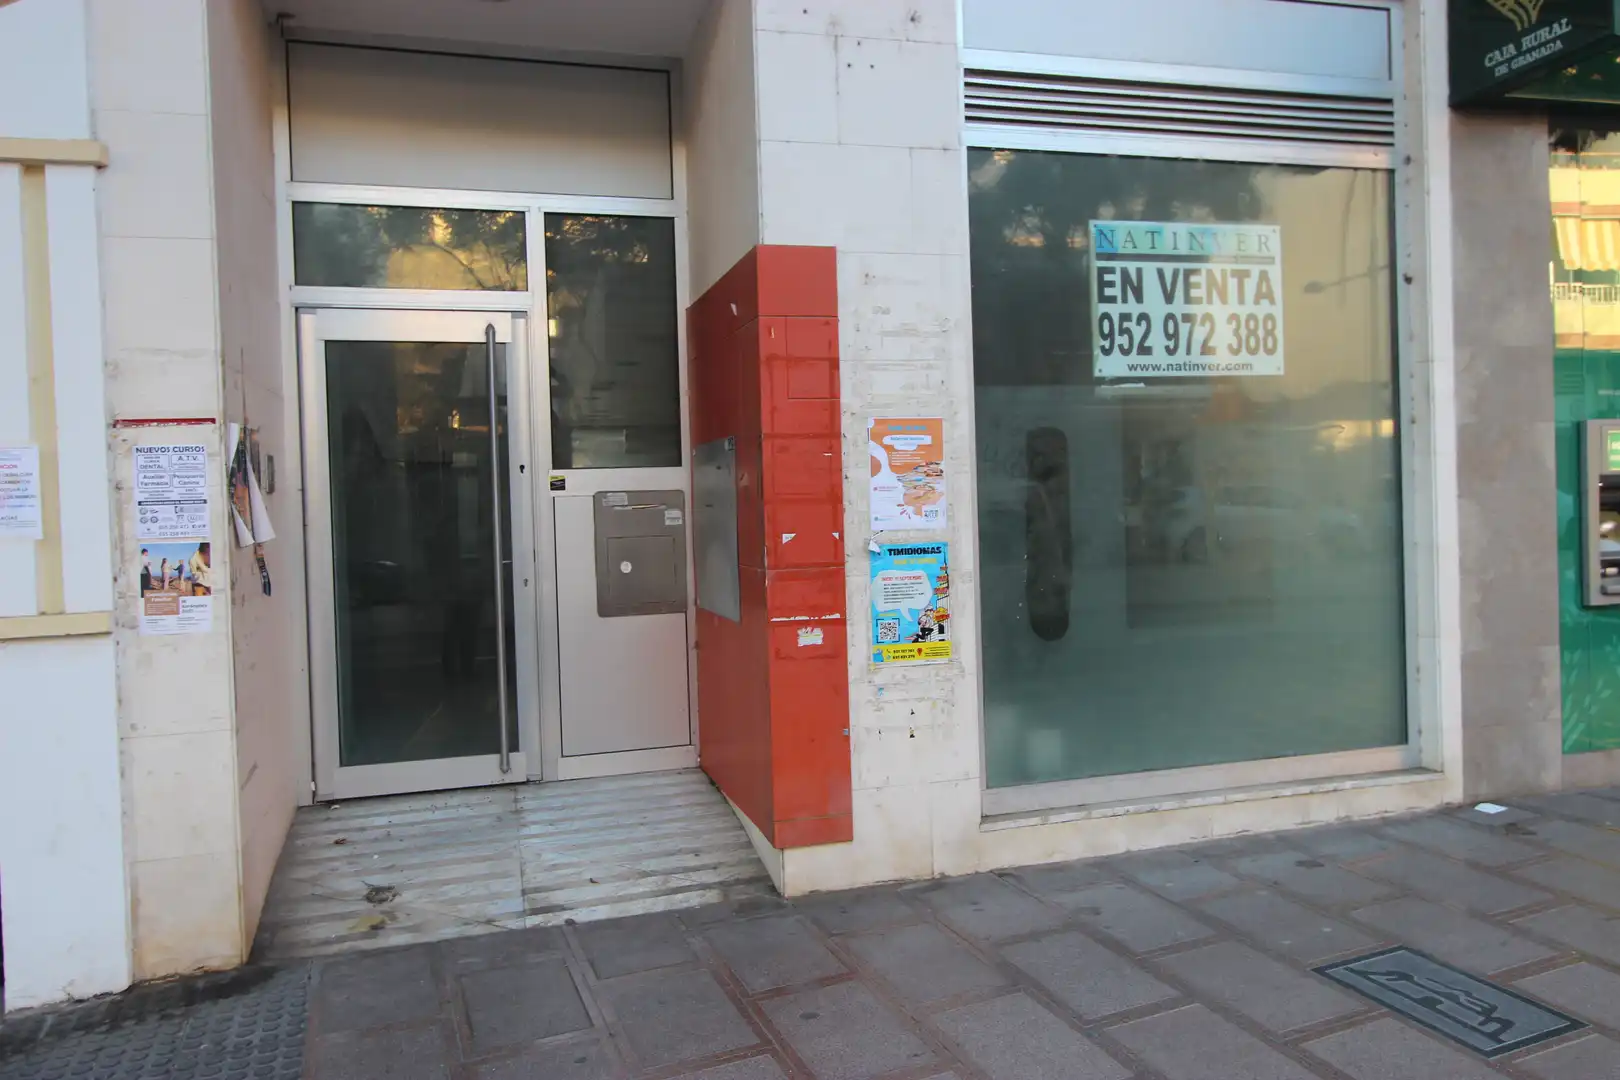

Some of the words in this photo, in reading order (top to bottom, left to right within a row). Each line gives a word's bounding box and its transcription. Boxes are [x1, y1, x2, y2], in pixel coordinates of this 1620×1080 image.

[1484, 43, 1517, 67] CAJA
[1520, 18, 1572, 51] RURAL
[1494, 63, 1509, 77] DE
[1510, 40, 1563, 70] GRANADA
[1096, 228, 1271, 253] NATINVER
[1097, 266, 1144, 304] EN
[1156, 267, 1277, 305] VENTA
[1098, 312, 1153, 357] 952
[1163, 312, 1217, 357] 972
[1227, 312, 1278, 356] 388
[1127, 361, 1253, 372] www.natinver.com
[135, 446, 171, 454] NUEVOS
[172, 445, 205, 453] CURSOS
[887, 546, 942, 556] TIMIDIOMAS
